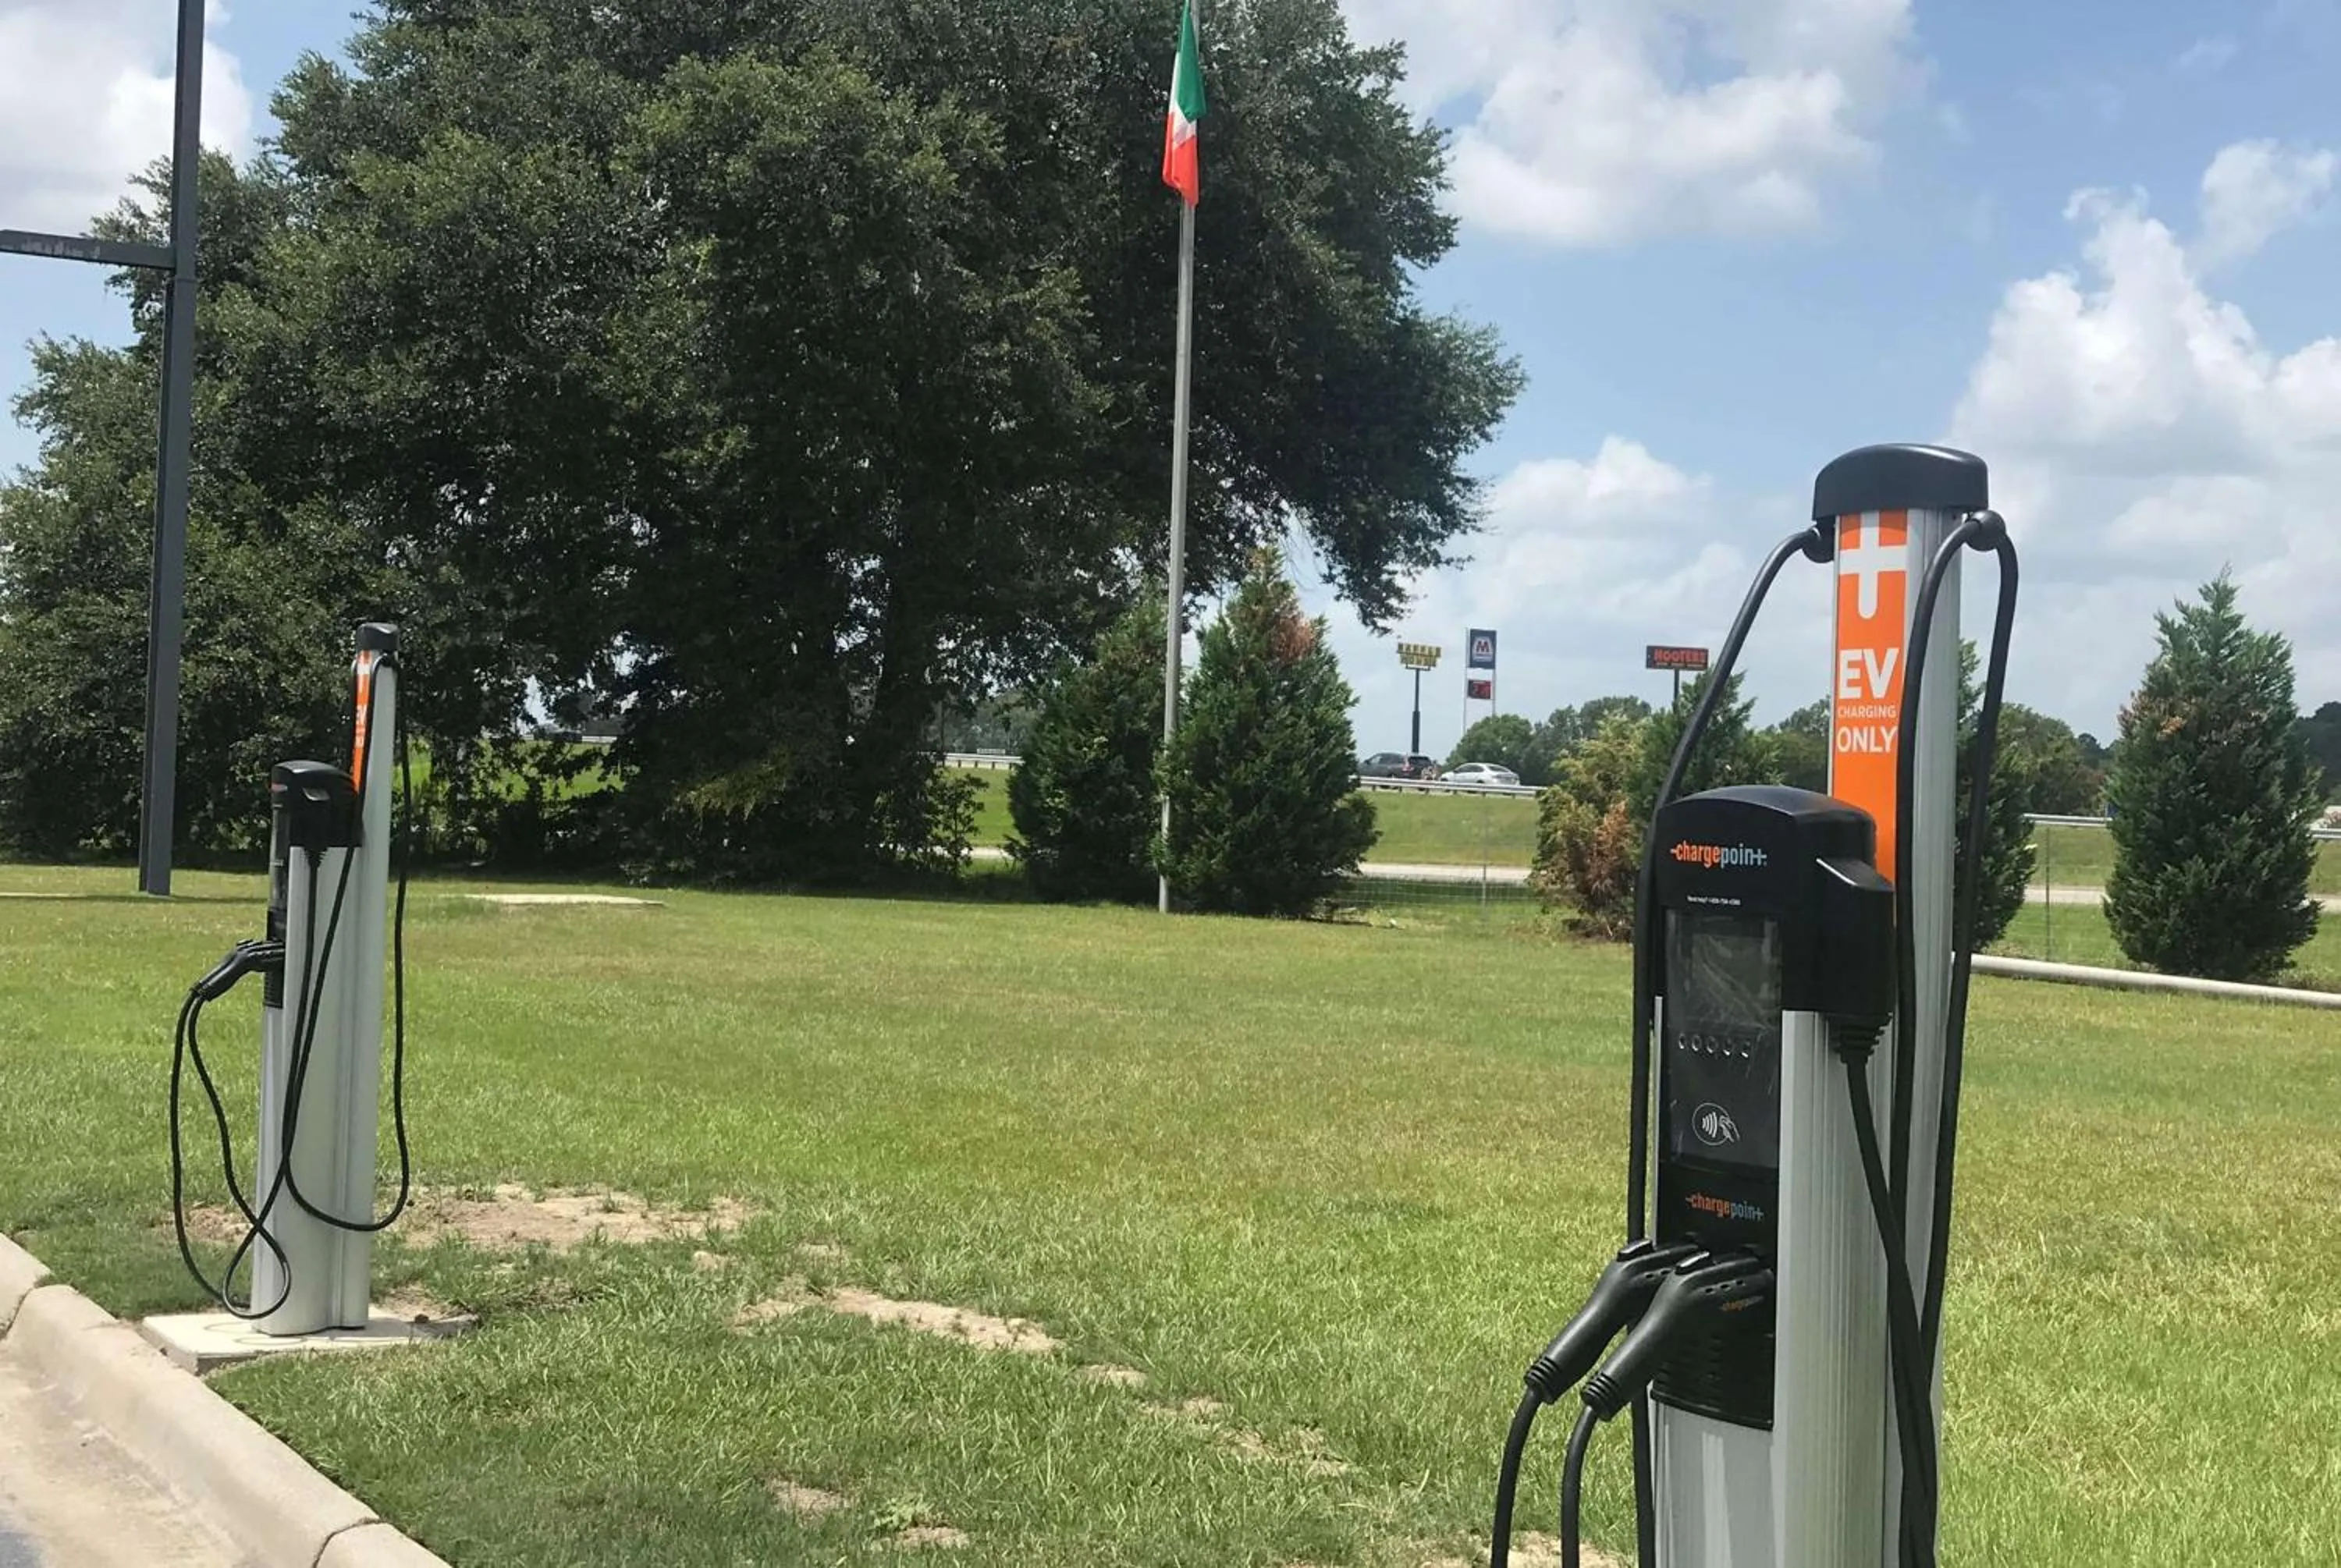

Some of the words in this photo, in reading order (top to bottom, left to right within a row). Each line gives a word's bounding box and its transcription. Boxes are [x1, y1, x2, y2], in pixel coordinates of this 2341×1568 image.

[1838, 647, 1899, 700] EV
[1838, 705, 1897, 718] CHARGING
[1836, 725, 1899, 754] ONLY
